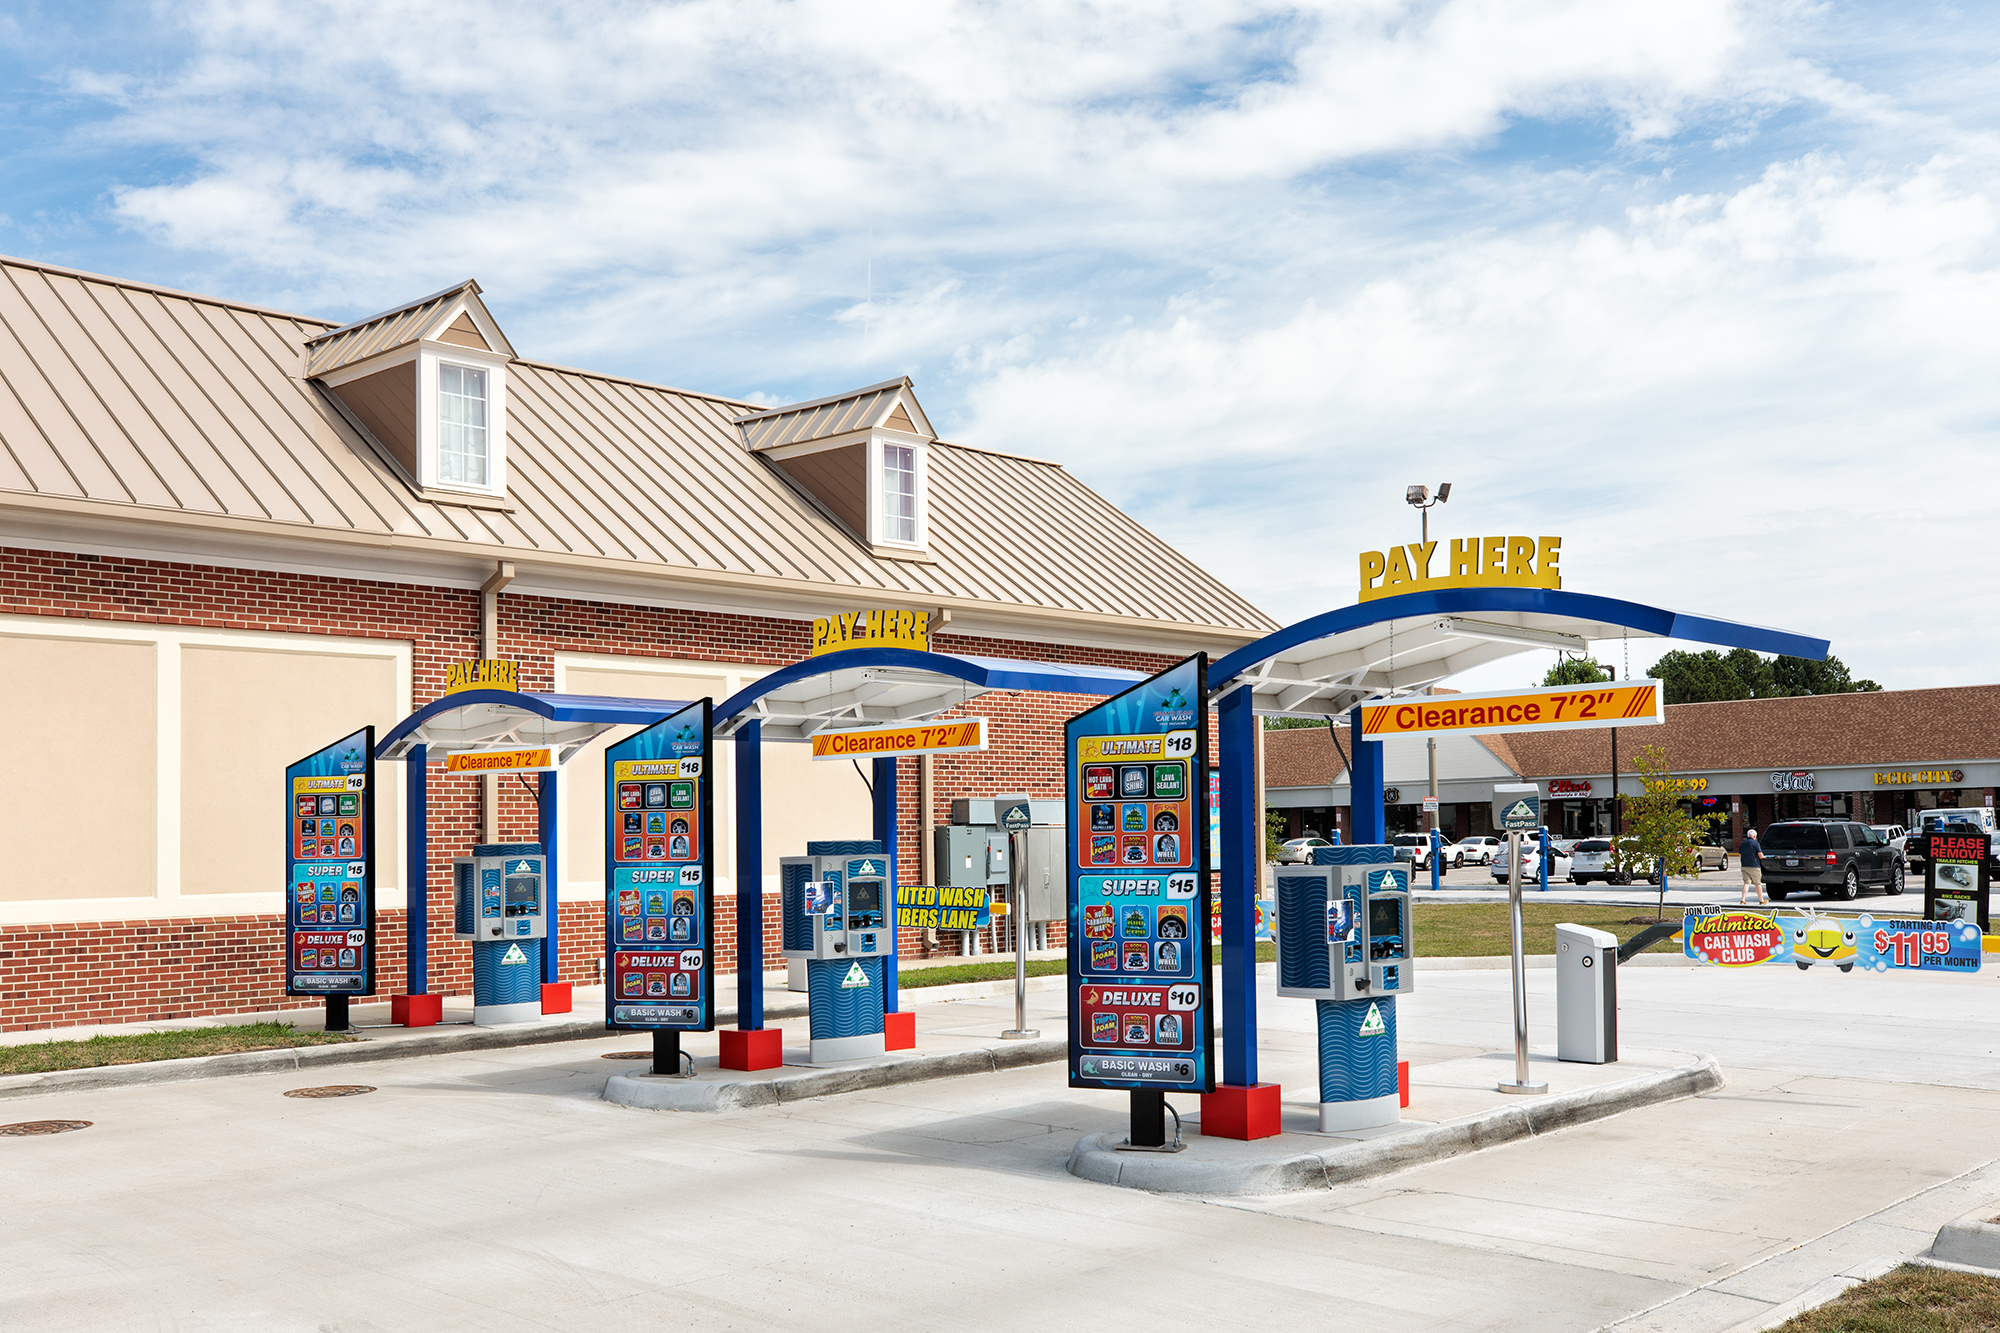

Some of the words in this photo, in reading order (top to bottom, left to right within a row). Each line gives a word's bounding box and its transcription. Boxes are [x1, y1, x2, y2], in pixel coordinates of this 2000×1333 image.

[1359, 541, 1438, 590] PAY
[1450, 536, 1561, 578] HERE
[813, 611, 861, 647] PAY
[866, 609, 930, 640] HERE
[447, 660, 476, 687] PAY
[480, 659, 520, 684] HERE
[1396, 703, 1541, 730] Clearance
[832, 734, 916, 753] Clearance
[1101, 740, 1161, 755] ULTIMATE
[1167, 737, 1192, 751] $18
[460, 755, 512, 770] Clearance
[631, 764, 676, 775] ULTIMATE
[681, 762, 699, 773] $18
[308, 779, 344, 789] ULTIMATE
[348, 778, 362, 787] $18
[1770, 772, 1814, 791] Hair
[1874, 772, 1912, 785] E-CIG
[1917, 770, 1953, 783] CITY
[1157, 781, 1180, 789] SEALANT
[1548, 780, 1592, 793] Ellen's
[1095, 844, 1113, 854] FOAM
[1930, 836, 1985, 849] PLEASE
[1930, 848, 1985, 859] REMOVE
[308, 866, 343, 876] SUPER
[348, 865, 363, 874] $15
[631, 870, 675, 883] SUPER
[682, 870, 700, 881] $15
[1101, 879, 1160, 896] SUPER
[1169, 879, 1194, 893] $15
[939, 887, 985, 908] WASH
[1685, 907, 1702, 916] JOIN
[1704, 906, 1721, 915] OUR
[940, 909, 978, 930] LANE
[1693, 910, 1777, 934] Unlimited
[1889, 920, 1933, 930] STARTING
[1935, 921, 1947, 931] AT
[307, 935, 343, 944] DELUXE
[348, 934, 363, 942] $10
[1704, 935, 1730, 950] CAR
[1733, 933, 1771, 948] WASH
[631, 956, 676, 967] DELUXE
[682, 955, 701, 966] $10
[1095, 950, 1114, 960] FOAM
[1722, 948, 1755, 963] CLUB
[1924, 956, 1942, 965] PER
[1944, 957, 1978, 968] MONTH
[1102, 991, 1161, 1006] DELUXE
[1171, 991, 1195, 1005] $10
[631, 1008, 656, 1016] BASIC
[658, 1009, 682, 1017] WASH
[682, 1008, 694, 1018] $6
[1096, 1022, 1115, 1031] FOAM
[1102, 1060, 1135, 1070] BASIC
[1138, 1062, 1171, 1072] WASH
[1174, 1063, 1189, 1076] $6
